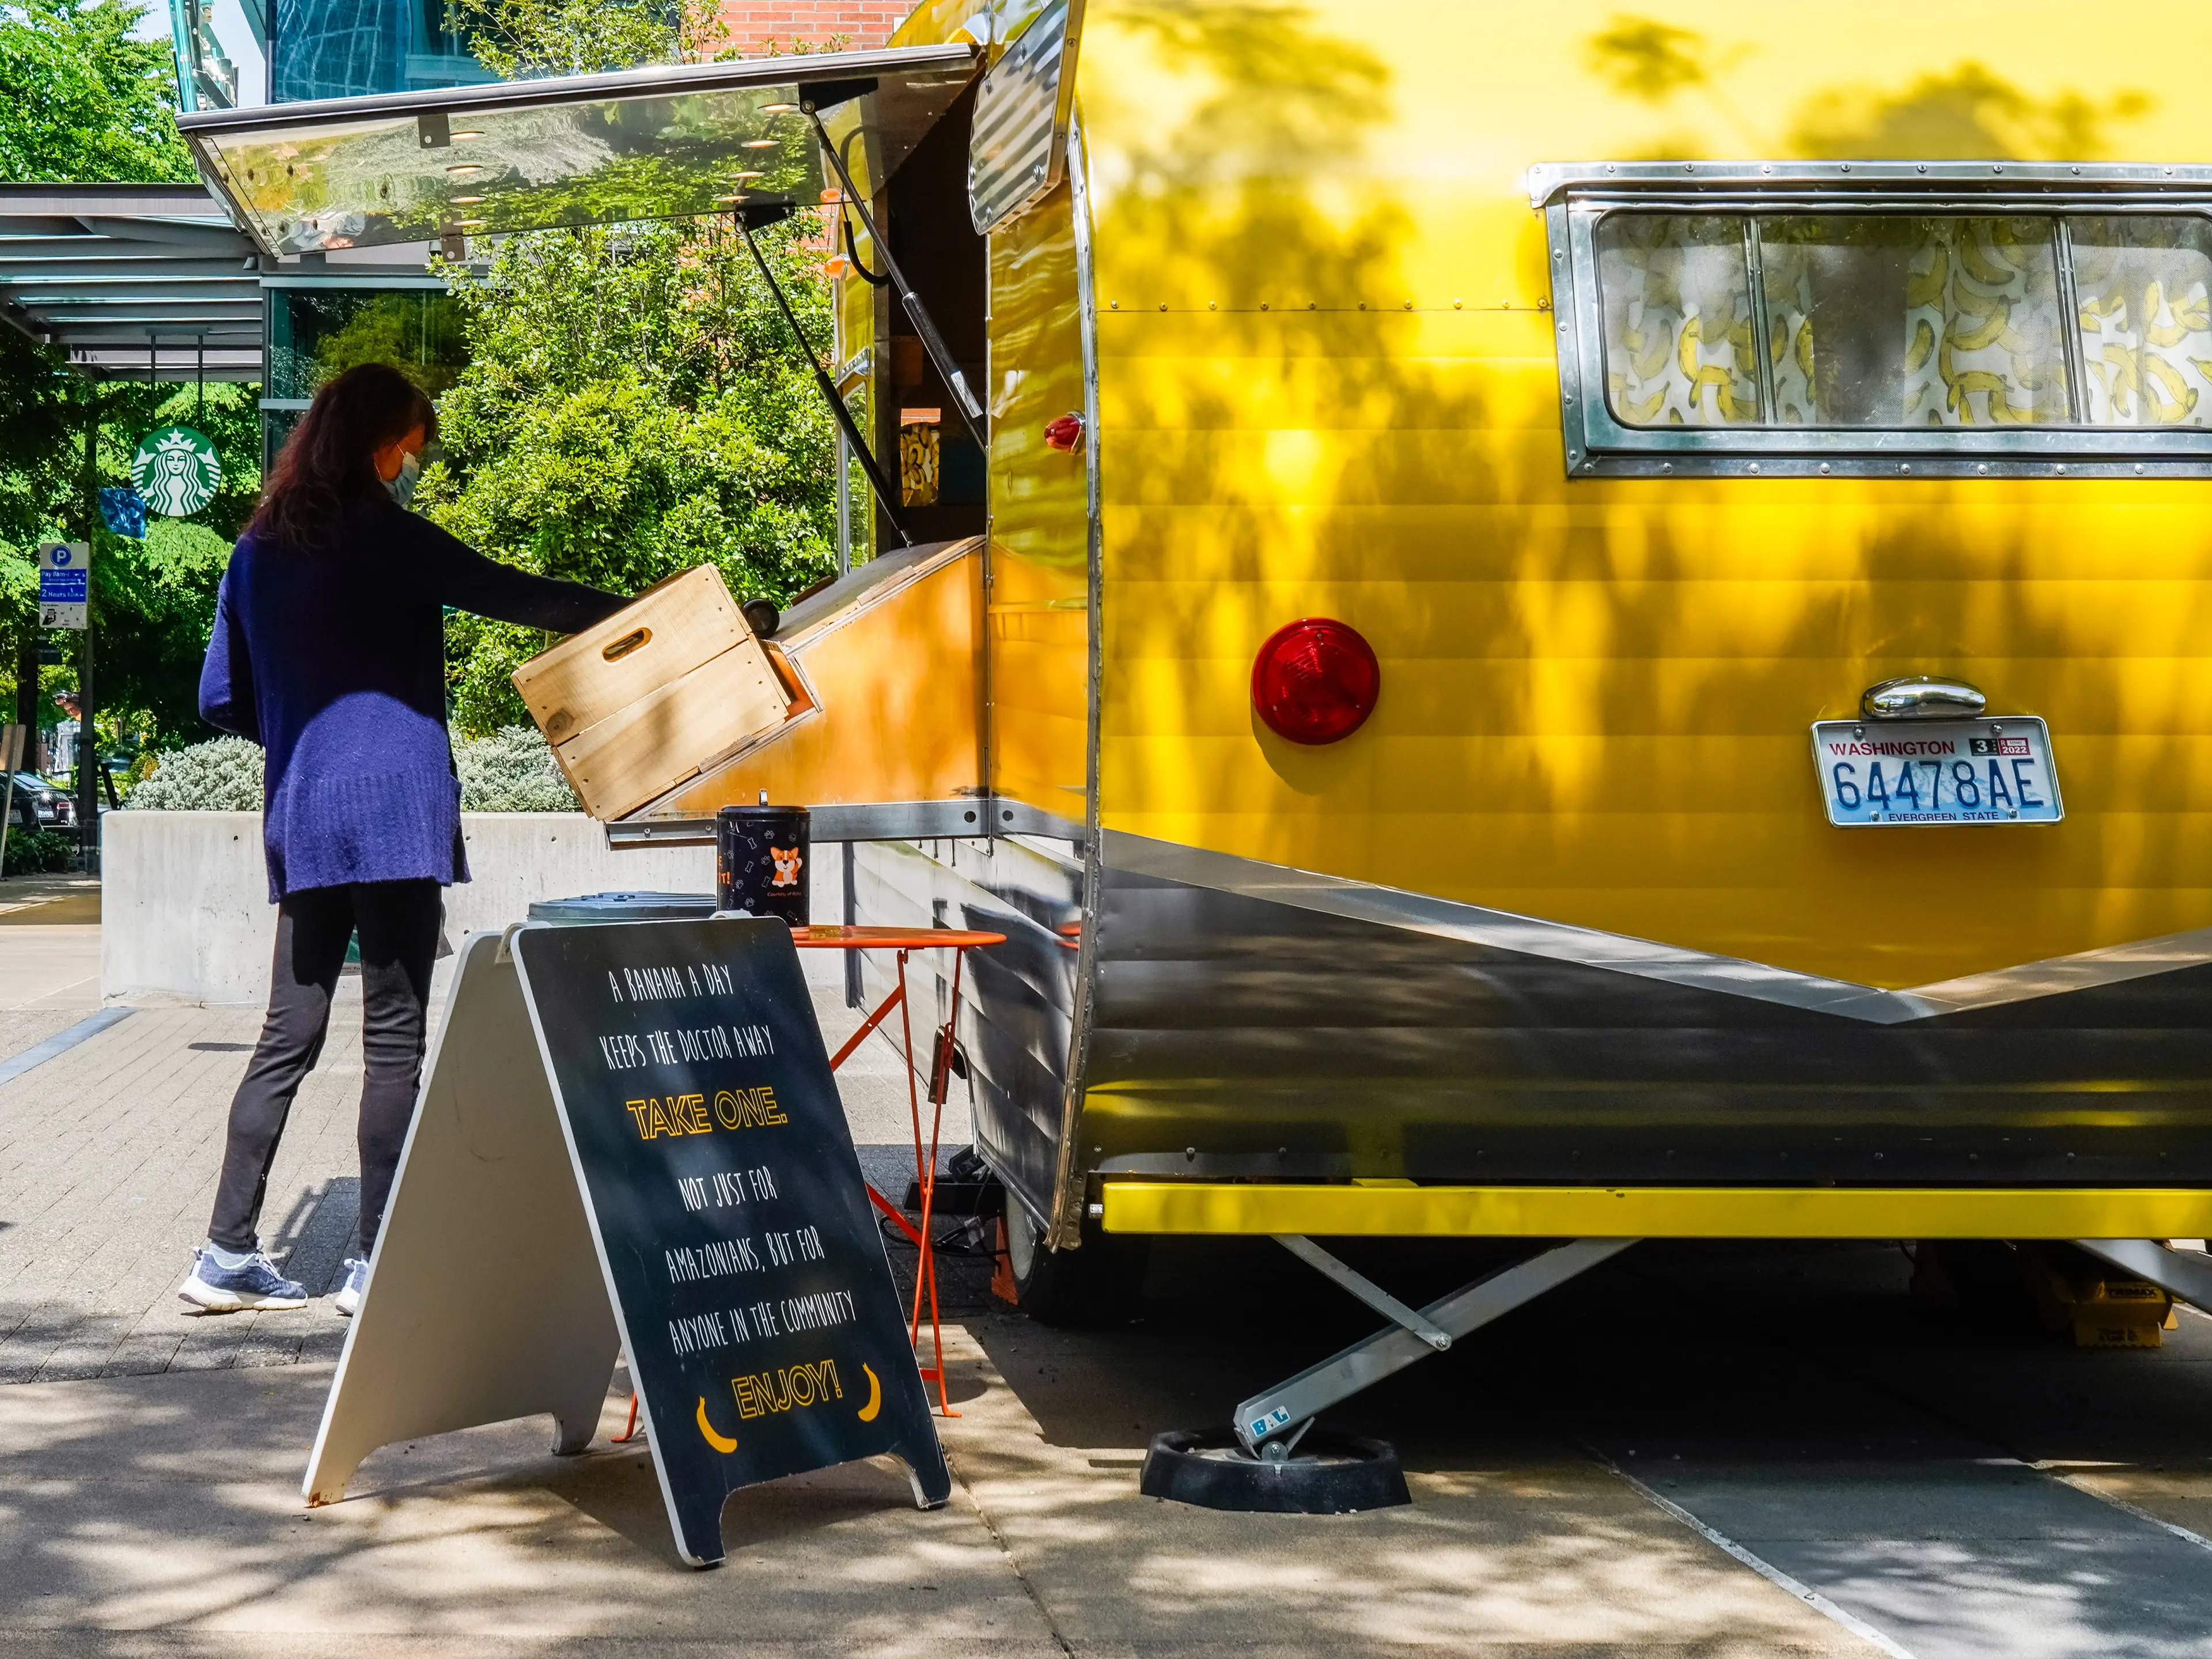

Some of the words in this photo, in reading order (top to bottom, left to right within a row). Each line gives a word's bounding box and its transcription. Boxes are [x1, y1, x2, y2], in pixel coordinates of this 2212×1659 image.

[56, 550, 67, 562] P
[41, 589, 47, 597] 2
[1830, 741, 1955, 756] WASHINGTON
[1975, 740, 1988, 752] 3
[1833, 758, 2044, 810] 64478AE
[1889, 813, 1957, 821] EVERGREEN
[1963, 811, 1999, 821] STATE
[609, 971, 623, 1002] A
[624, 967, 686, 1001] BANANA
[688, 965, 702, 997] A
[702, 963, 733, 995] DAY
[599, 1034, 646, 1070] KEEPS
[646, 1030, 678, 1065] THE
[677, 1025, 732, 1062] DOCTOR
[733, 1024, 775, 1058] AWAY
[626, 1093, 712, 1140] TAKE
[714, 1086, 787, 1130] ONE.
[678, 1175, 708, 1212] NOT
[712, 1172, 746, 1207] JUST
[749, 1165, 778, 1201] FOR
[665, 1237, 765, 1283] AMAZONIANS,
[766, 1232, 794, 1266] BUT
[797, 1225, 825, 1260] FOR
[669, 1312, 728, 1354] ANYONE
[729, 1308, 749, 1343] IN
[750, 1301, 779, 1337] THE
[781, 1290, 857, 1332] COMMUNITY
[732, 1359, 843, 1419] ENJOY!
